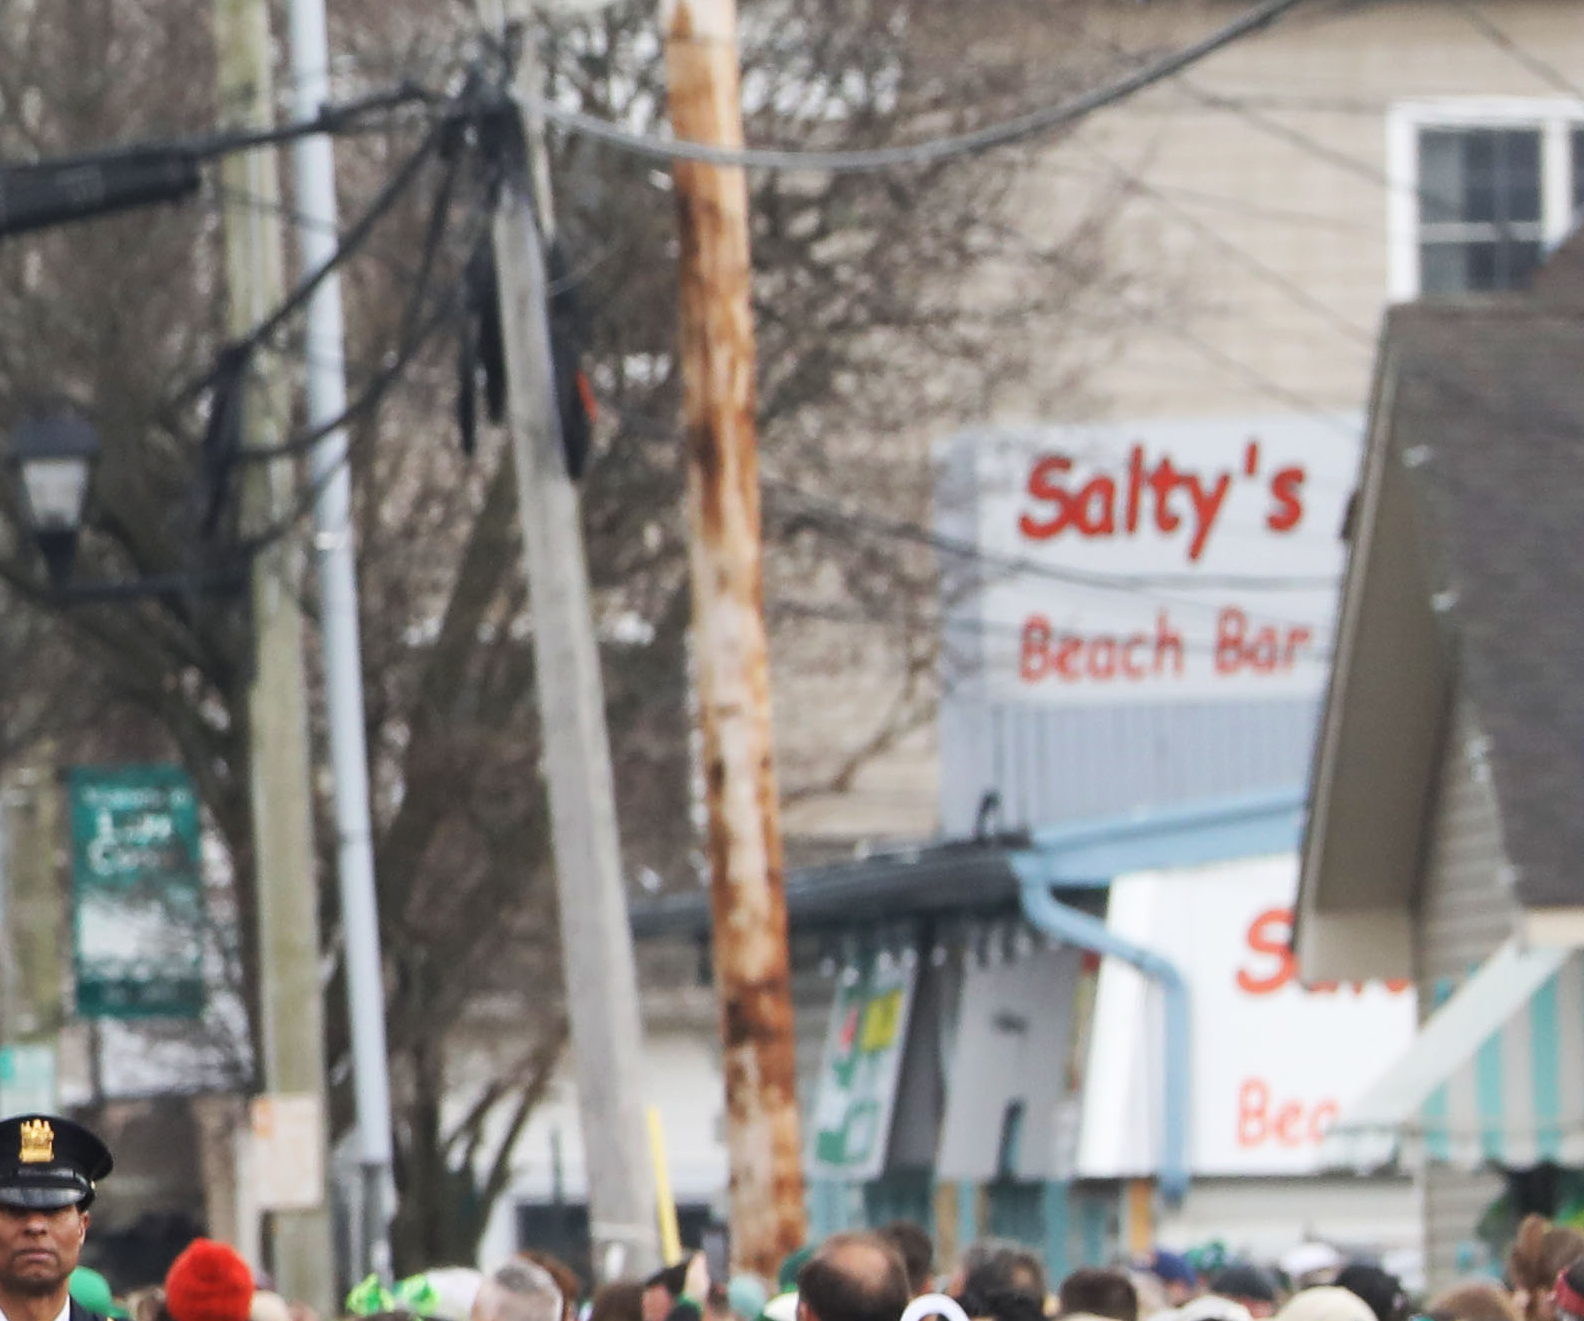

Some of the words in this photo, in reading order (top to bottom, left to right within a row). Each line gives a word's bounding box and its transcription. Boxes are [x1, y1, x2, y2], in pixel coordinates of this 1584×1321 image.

[1017, 443, 1307, 560] Salty's
[1019, 609, 1185, 683] Beach
[1213, 608, 1314, 674] Bar
